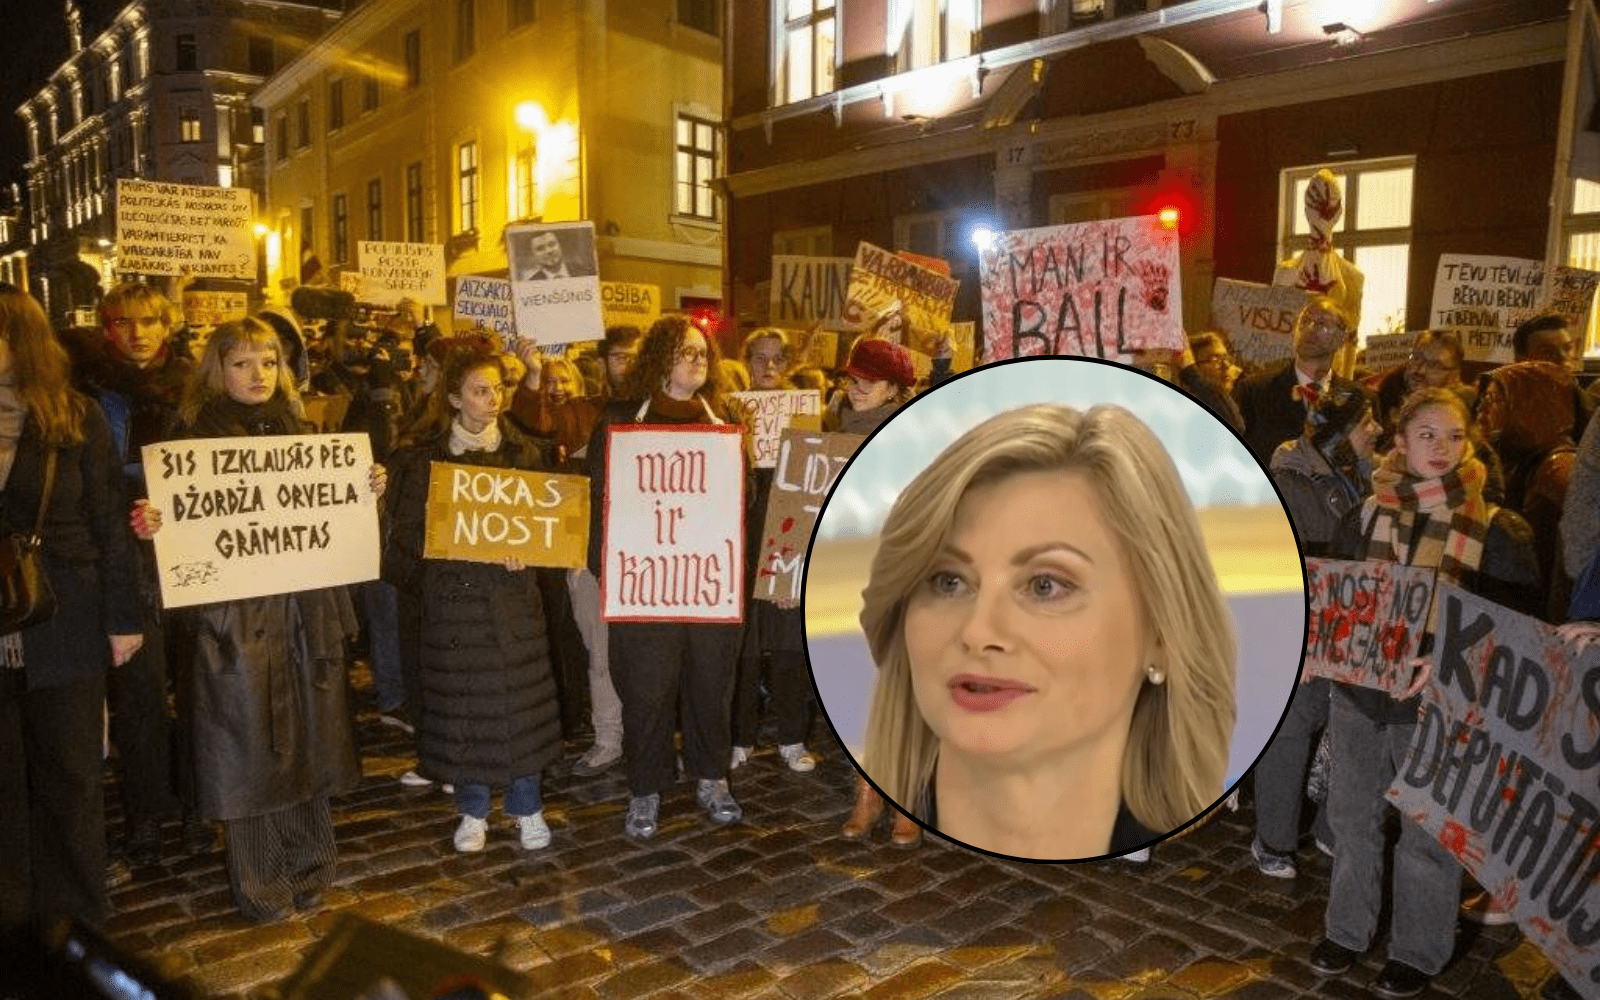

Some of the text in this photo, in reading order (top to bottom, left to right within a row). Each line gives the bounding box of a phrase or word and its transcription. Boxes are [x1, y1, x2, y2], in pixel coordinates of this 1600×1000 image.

[156, 184, 179, 196] VAR
[190, 216, 209, 227] BET
[1008, 242, 1085, 298] MAN
[1443, 263, 1487, 281] TĒVU
[1239, 304, 1293, 334] VISUS
[161, 439, 356, 480] ŠIS IZKLAUSĀS PĒC
[636, 449, 707, 494] man
[172, 479, 359, 522] DŽORDŽA ORVELA
[452, 468, 562, 509] ROKAS
[215, 521, 331, 559] GRĀMATAS
[454, 511, 560, 549] NOST
[654, 500, 685, 546] ir
[618, 538, 734, 607] kauns!
[1328, 571, 1385, 610] NOST
[1389, 578, 1428, 625] NO
[1438, 595, 1548, 732] KAD
